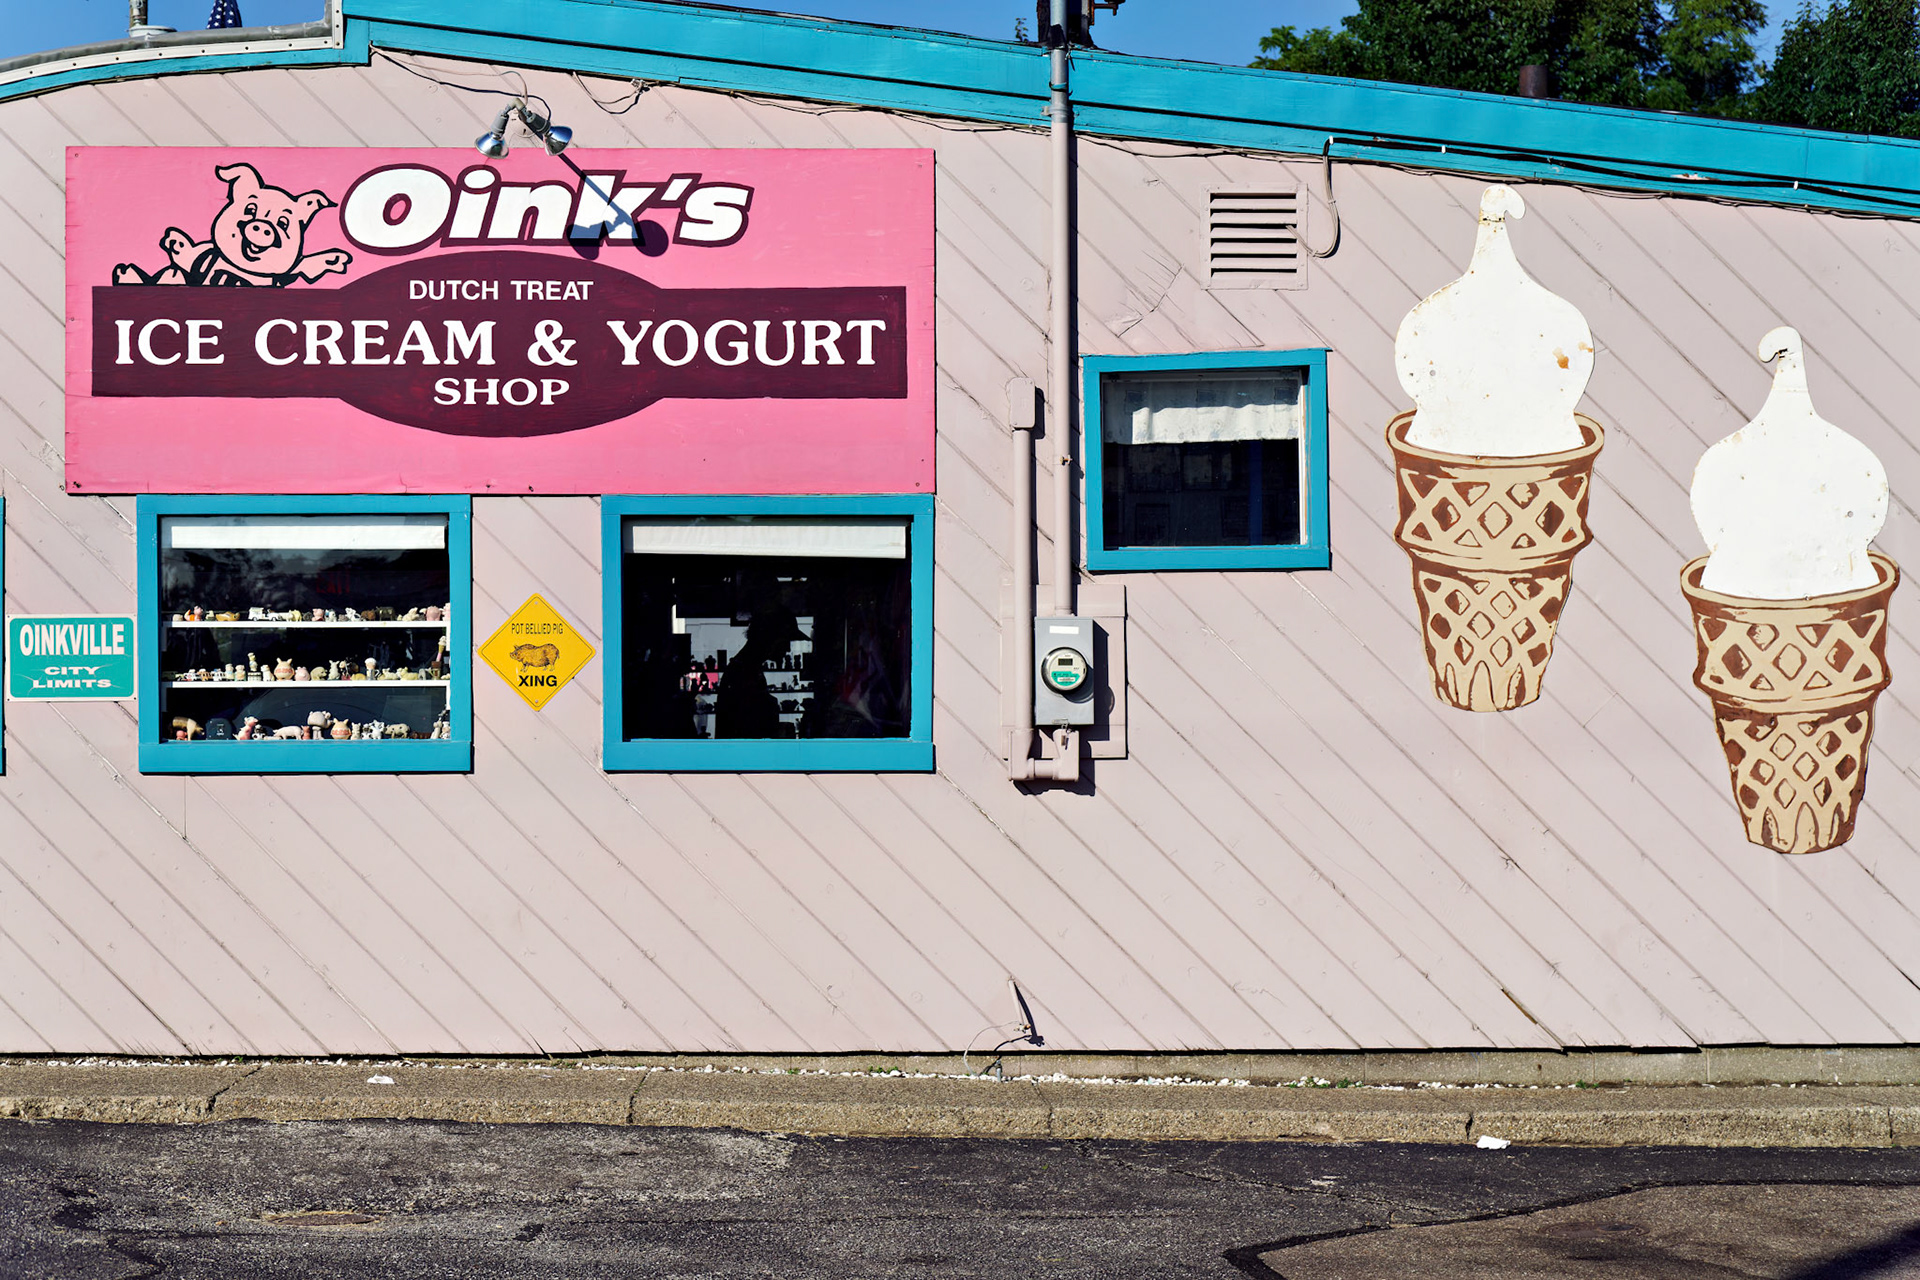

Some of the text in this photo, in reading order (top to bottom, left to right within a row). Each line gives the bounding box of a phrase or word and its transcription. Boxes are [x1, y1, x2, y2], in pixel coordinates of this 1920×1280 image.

[342, 165, 752, 253] Oink's
[409, 279, 594, 301] DUTCH TREAT
[114, 318, 887, 367] ICE CREAM & YOGURT
[433, 377, 570, 406] SHOP
[20, 624, 125, 656] OINKVILLE
[511, 623, 563, 635] POT BELLIED PIG
[44, 666, 100, 676] CITY
[518, 675, 558, 687] XING
[32, 679, 112, 688] LIMITS
